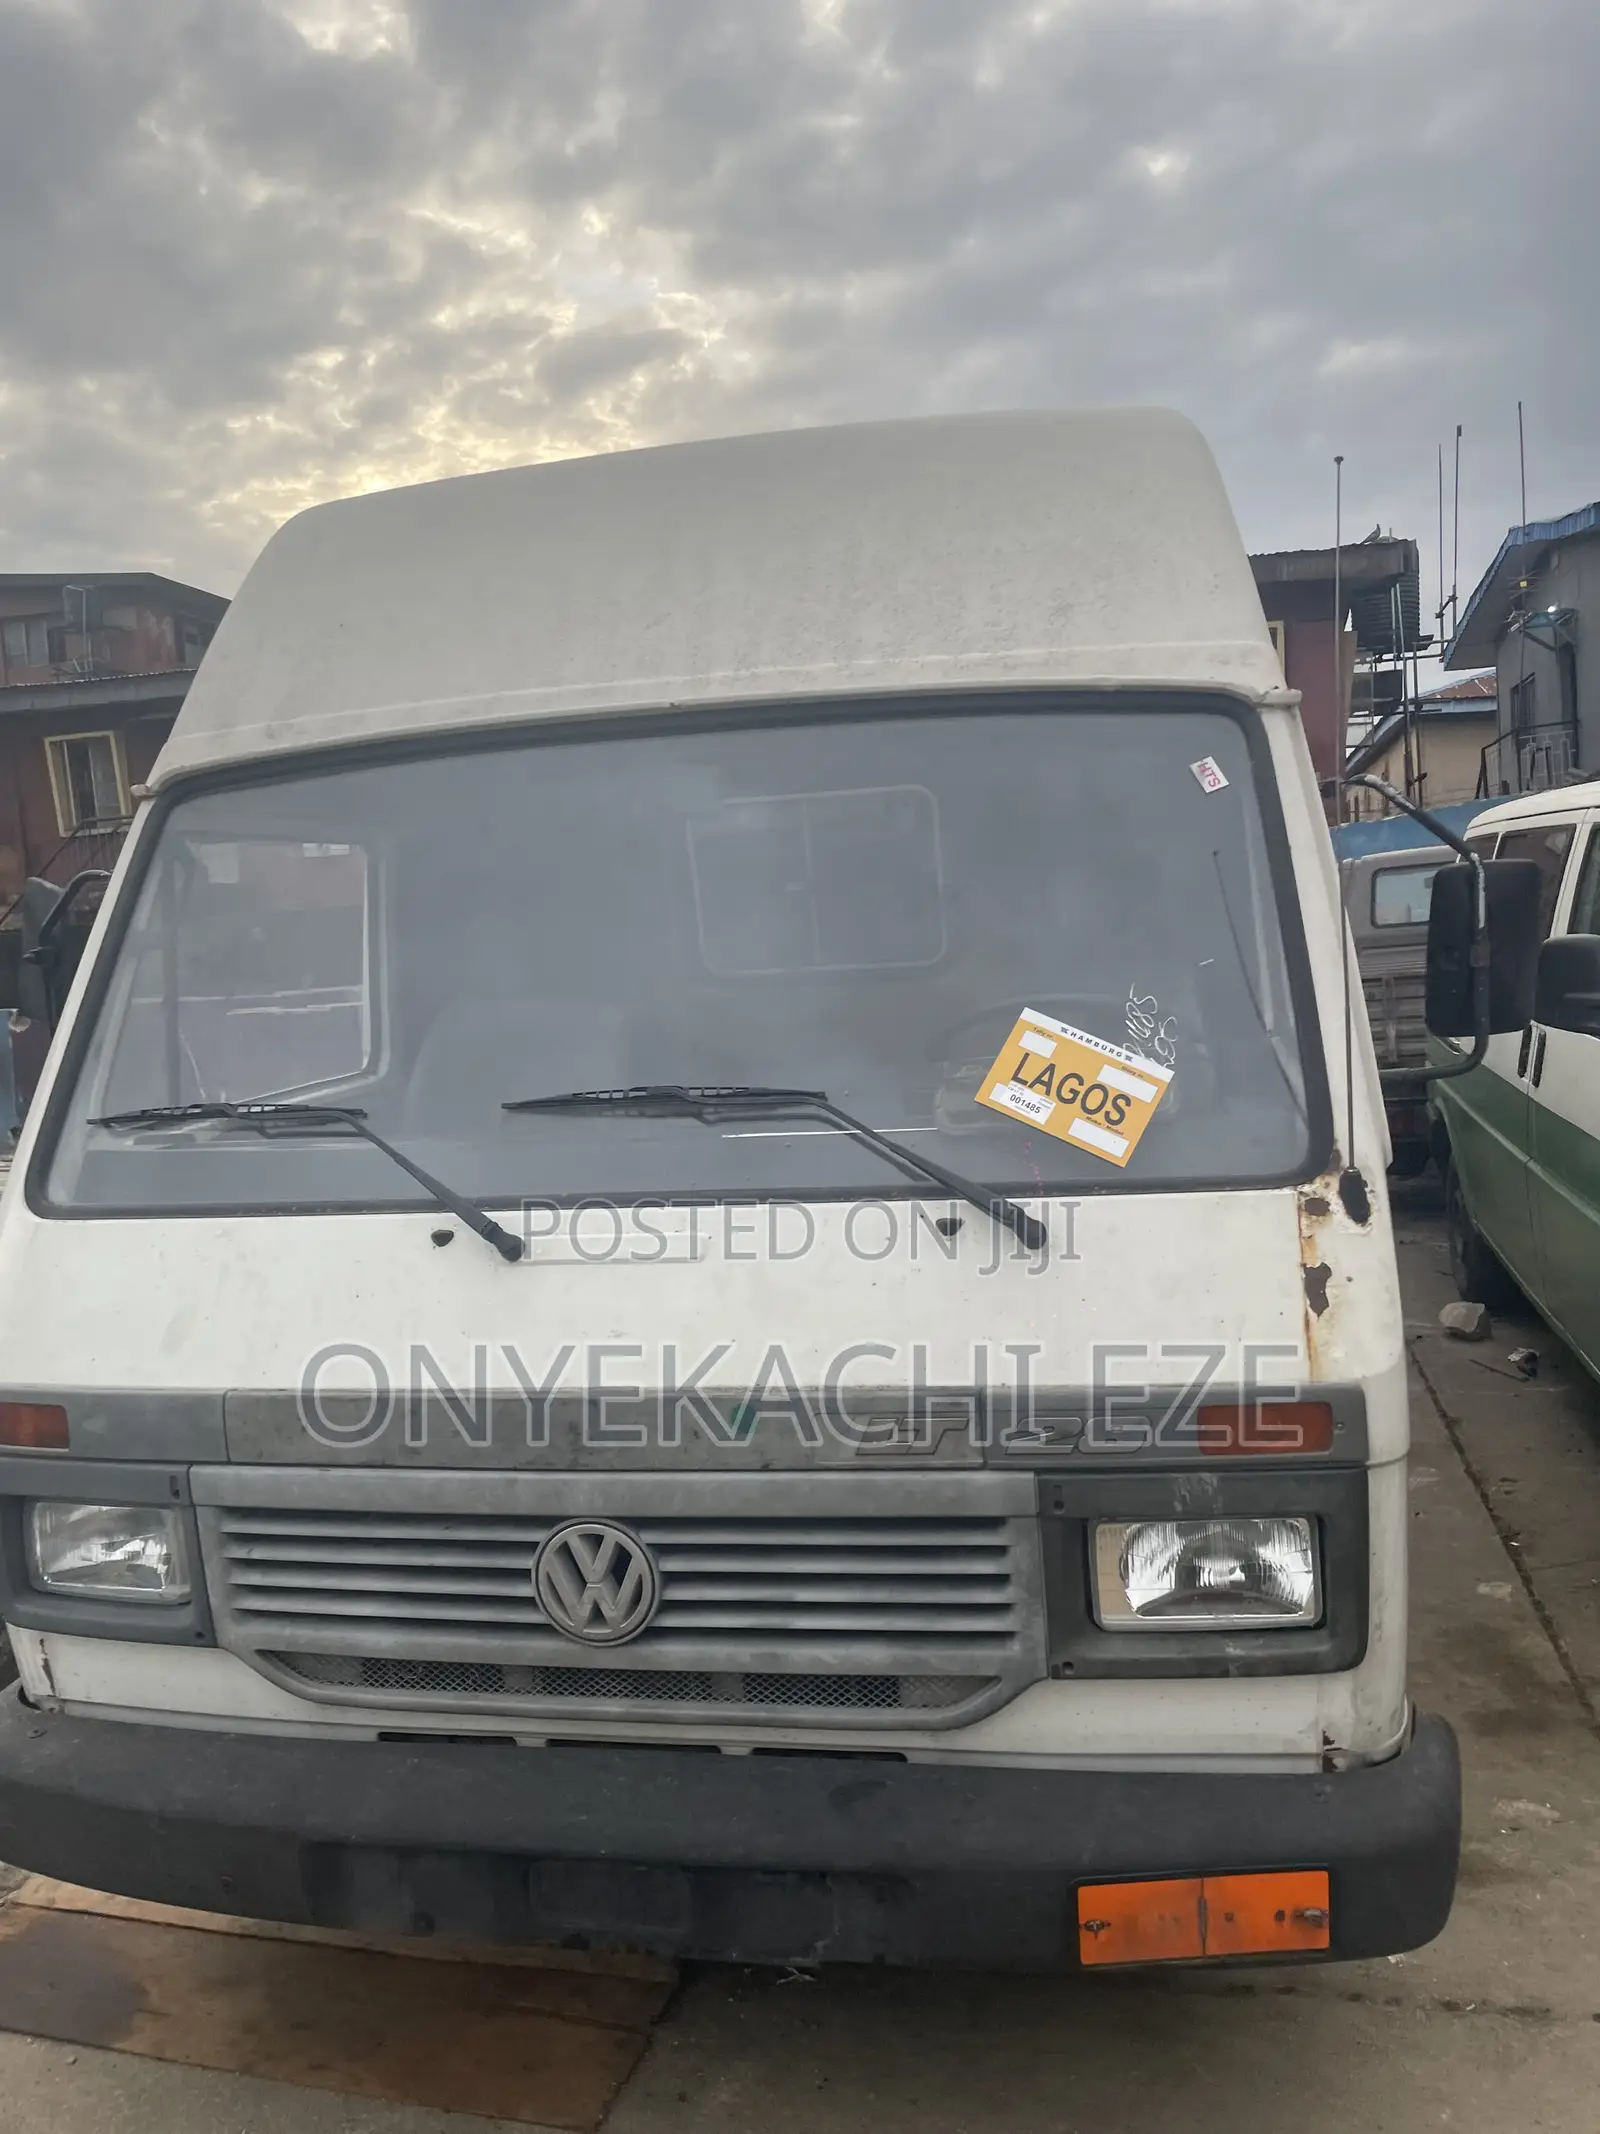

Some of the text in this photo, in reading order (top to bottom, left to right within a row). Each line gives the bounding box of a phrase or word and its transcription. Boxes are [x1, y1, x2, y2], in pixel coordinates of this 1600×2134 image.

[1196, 761, 1221, 788] HTS
[1069, 1031, 1123, 1058] HAMBURG
[1009, 1093, 1042, 1114] 001485
[1011, 1052, 1131, 1126] LAGOS
[1004, 1416, 1151, 1455] 28
[538, 1522, 656, 1642] VW
